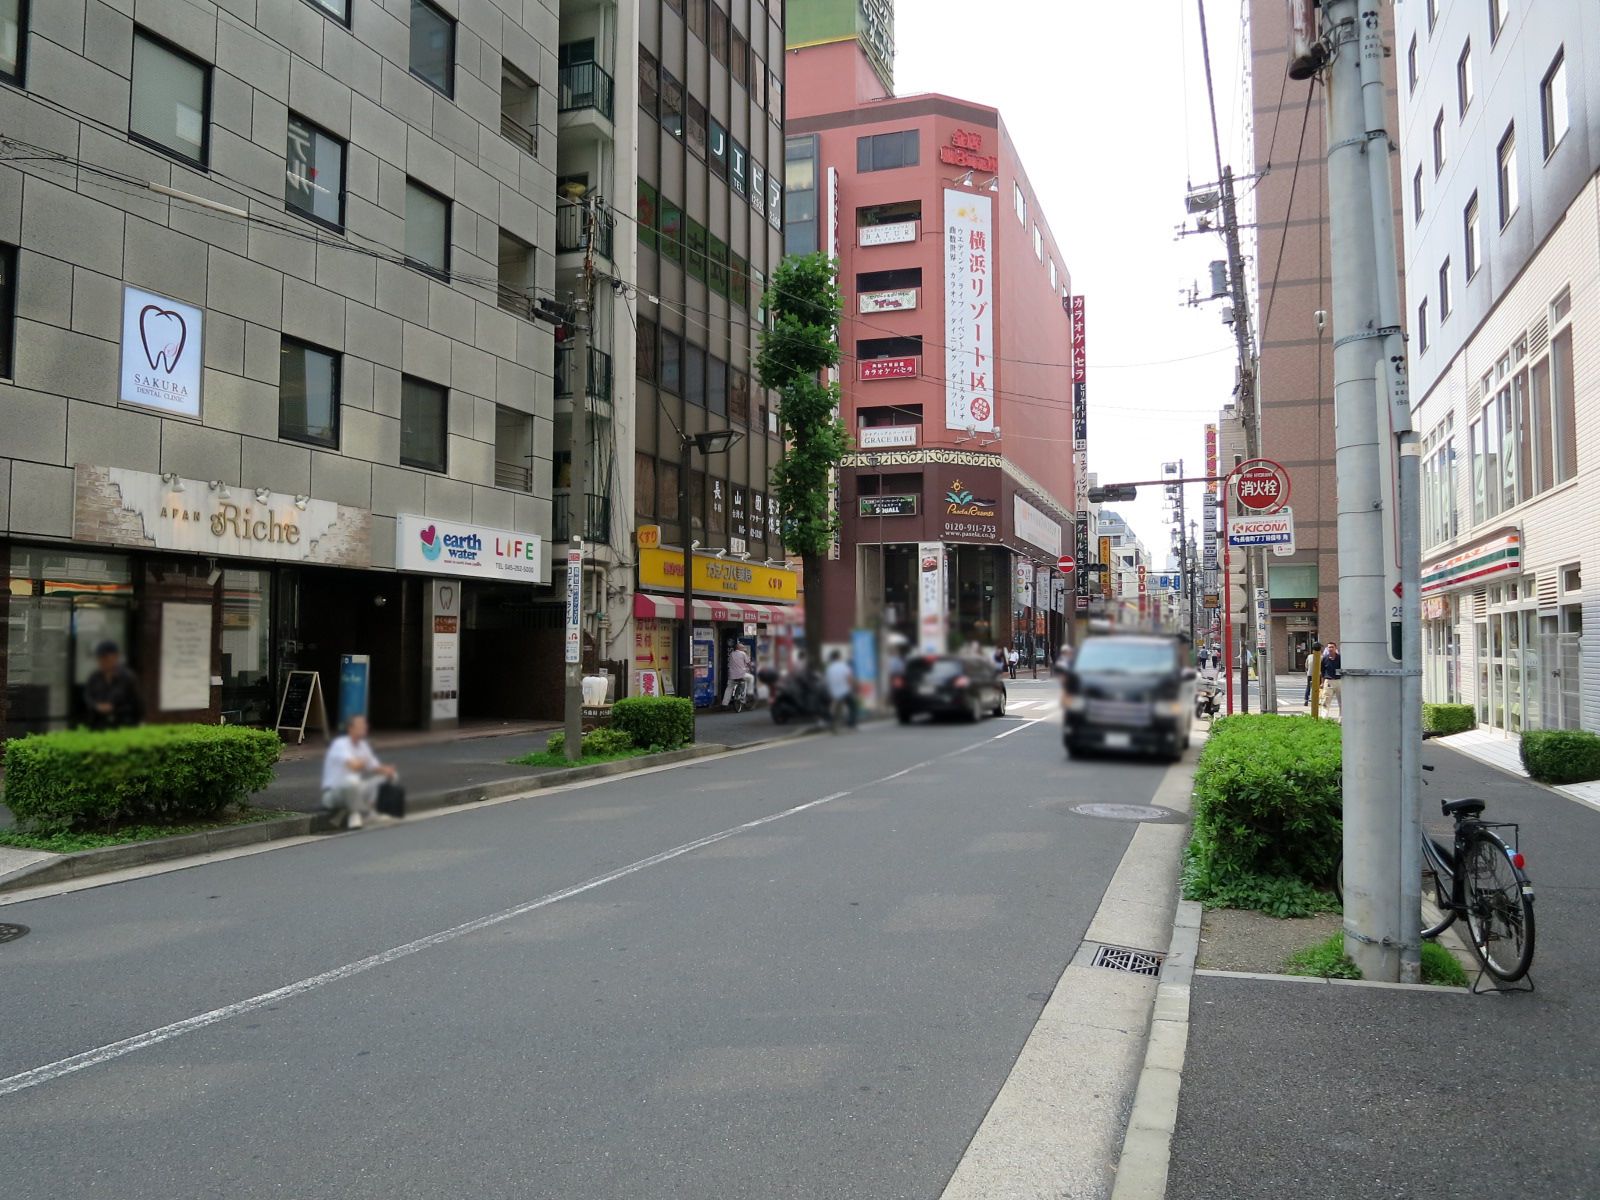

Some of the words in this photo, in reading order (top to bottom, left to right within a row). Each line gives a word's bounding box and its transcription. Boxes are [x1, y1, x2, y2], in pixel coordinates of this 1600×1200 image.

[1074, 297, 1084, 380] カラオケパセラ
[134, 373, 188, 395] SAKURA
[136, 386, 161, 398] DENTAL
[163, 393, 185, 403] CLINIC
[864, 436, 892, 444] GRACE
[1241, 480, 1278, 497] 消火栓
[210, 502, 300, 545] Riche
[945, 522, 996, 533] 0120-911-753
[1245, 523, 1288, 533] KICONA
[639, 532, 657, 543] くすり
[945, 531, 996, 539] www.pasela.co.jp
[443, 533, 482, 551] earth
[448, 549, 477, 560] water
[495, 537, 534, 560] LIFE
[495, 562, 504, 570] TEL
[768, 577, 783, 590] くすり
[714, 611, 726, 621] くすり
